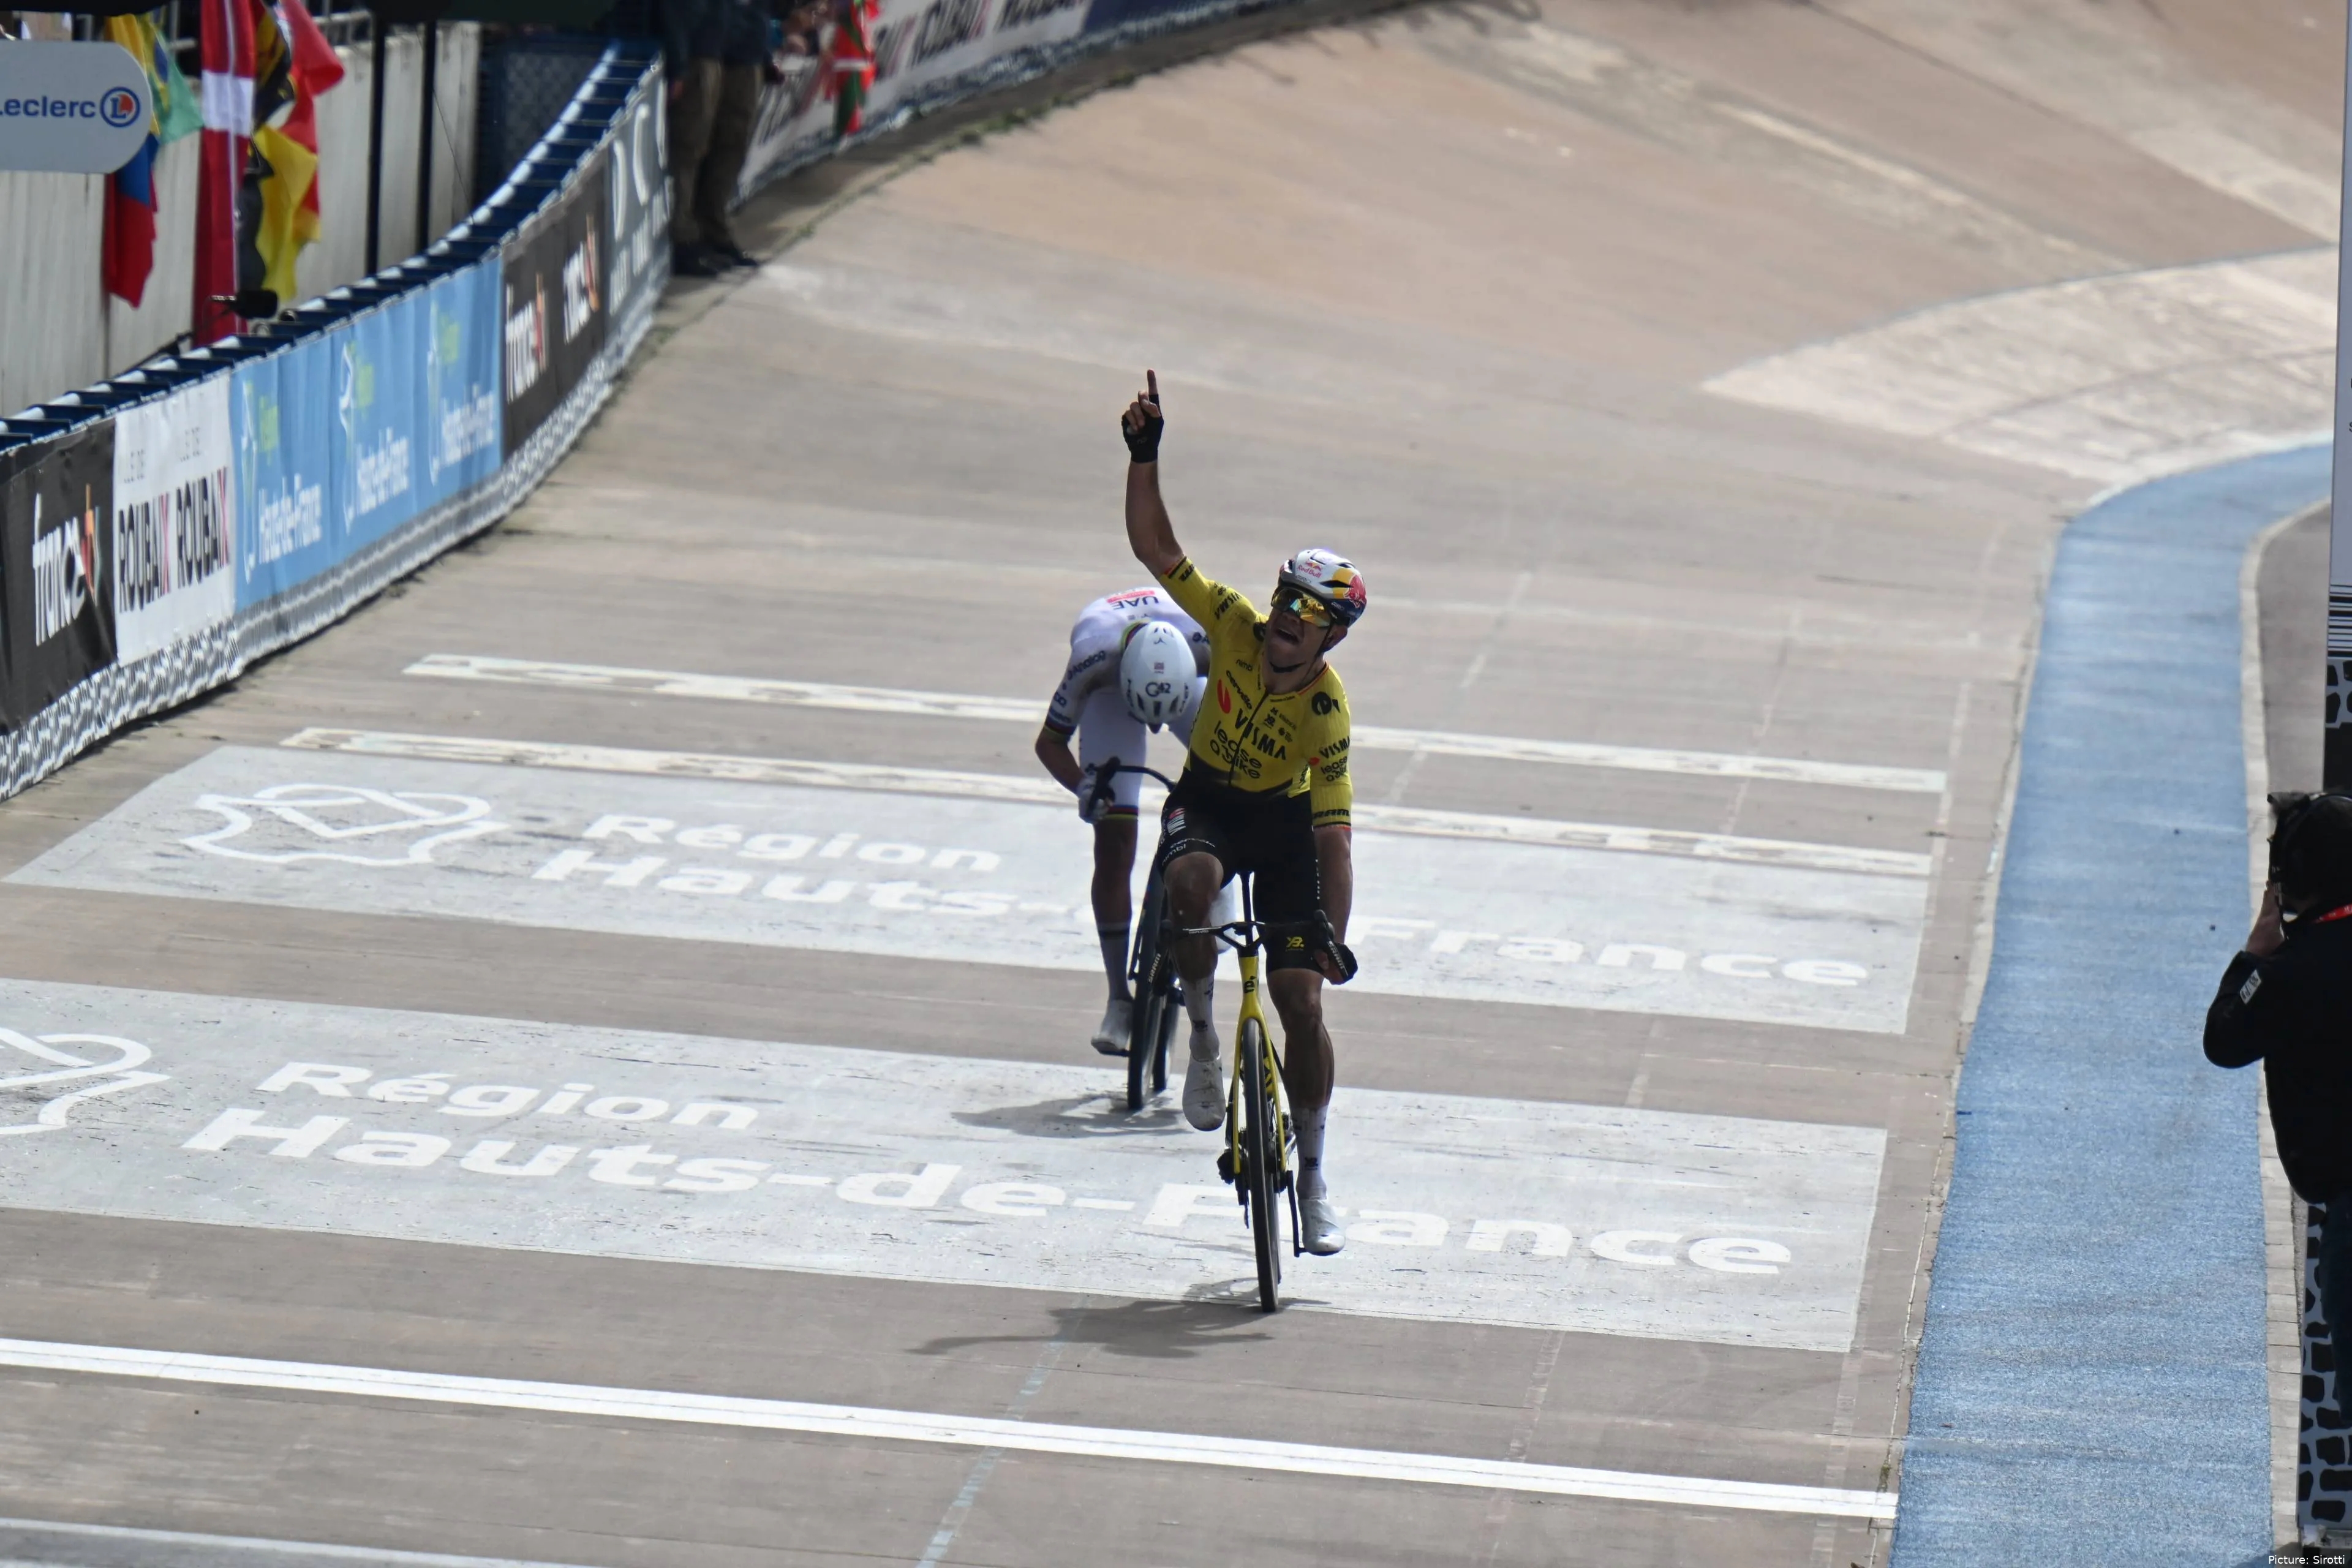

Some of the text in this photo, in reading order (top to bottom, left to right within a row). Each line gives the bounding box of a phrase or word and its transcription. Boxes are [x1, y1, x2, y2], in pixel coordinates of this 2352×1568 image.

[0, 96, 96, 118] eclerc
[118, 491, 171, 614] ROUBAIX
[176, 466, 230, 589] ROUBAIX
[1297, 564, 1322, 578] Red Bull
[1112, 595, 1159, 610] UAE
[1214, 720, 1262, 769] lease
[1235, 708, 1286, 760] VISMA
[582, 813, 1001, 872] Région
[255, 1061, 759, 1129] Région
[180, 1107, 1792, 1275] Hauts-de-Fance
